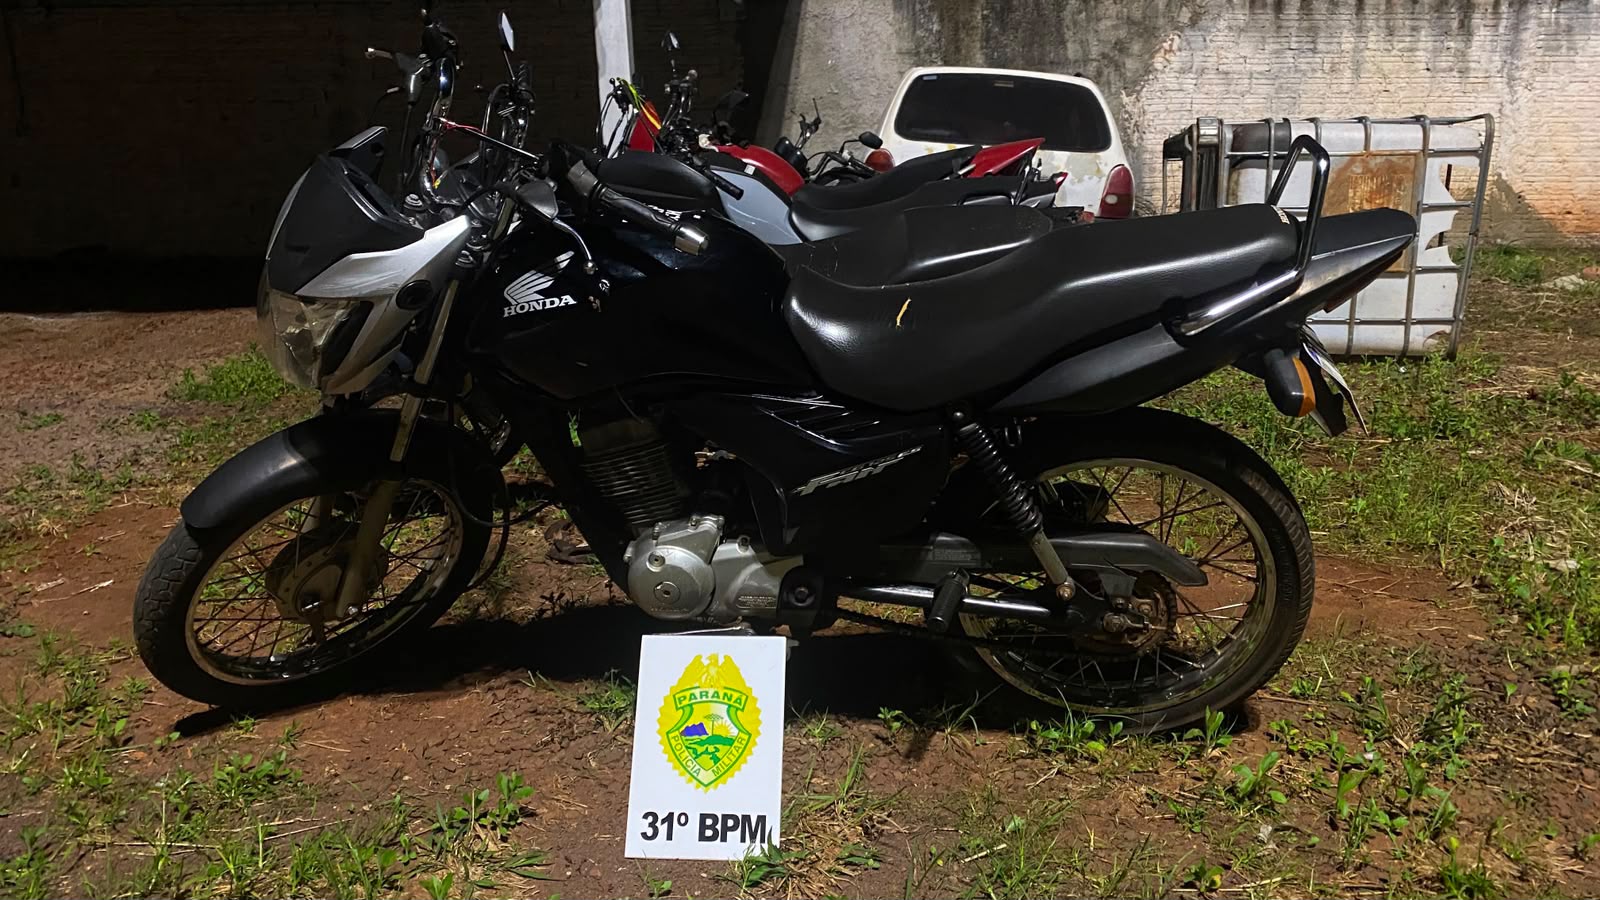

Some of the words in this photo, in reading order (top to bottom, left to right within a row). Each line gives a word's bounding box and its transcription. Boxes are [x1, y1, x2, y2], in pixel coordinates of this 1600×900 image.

[503, 295, 578, 317] HONDA
[677, 690, 743, 706] PARANÁ
[711, 736, 746, 777] MILITAR
[698, 813, 767, 844] BPM
